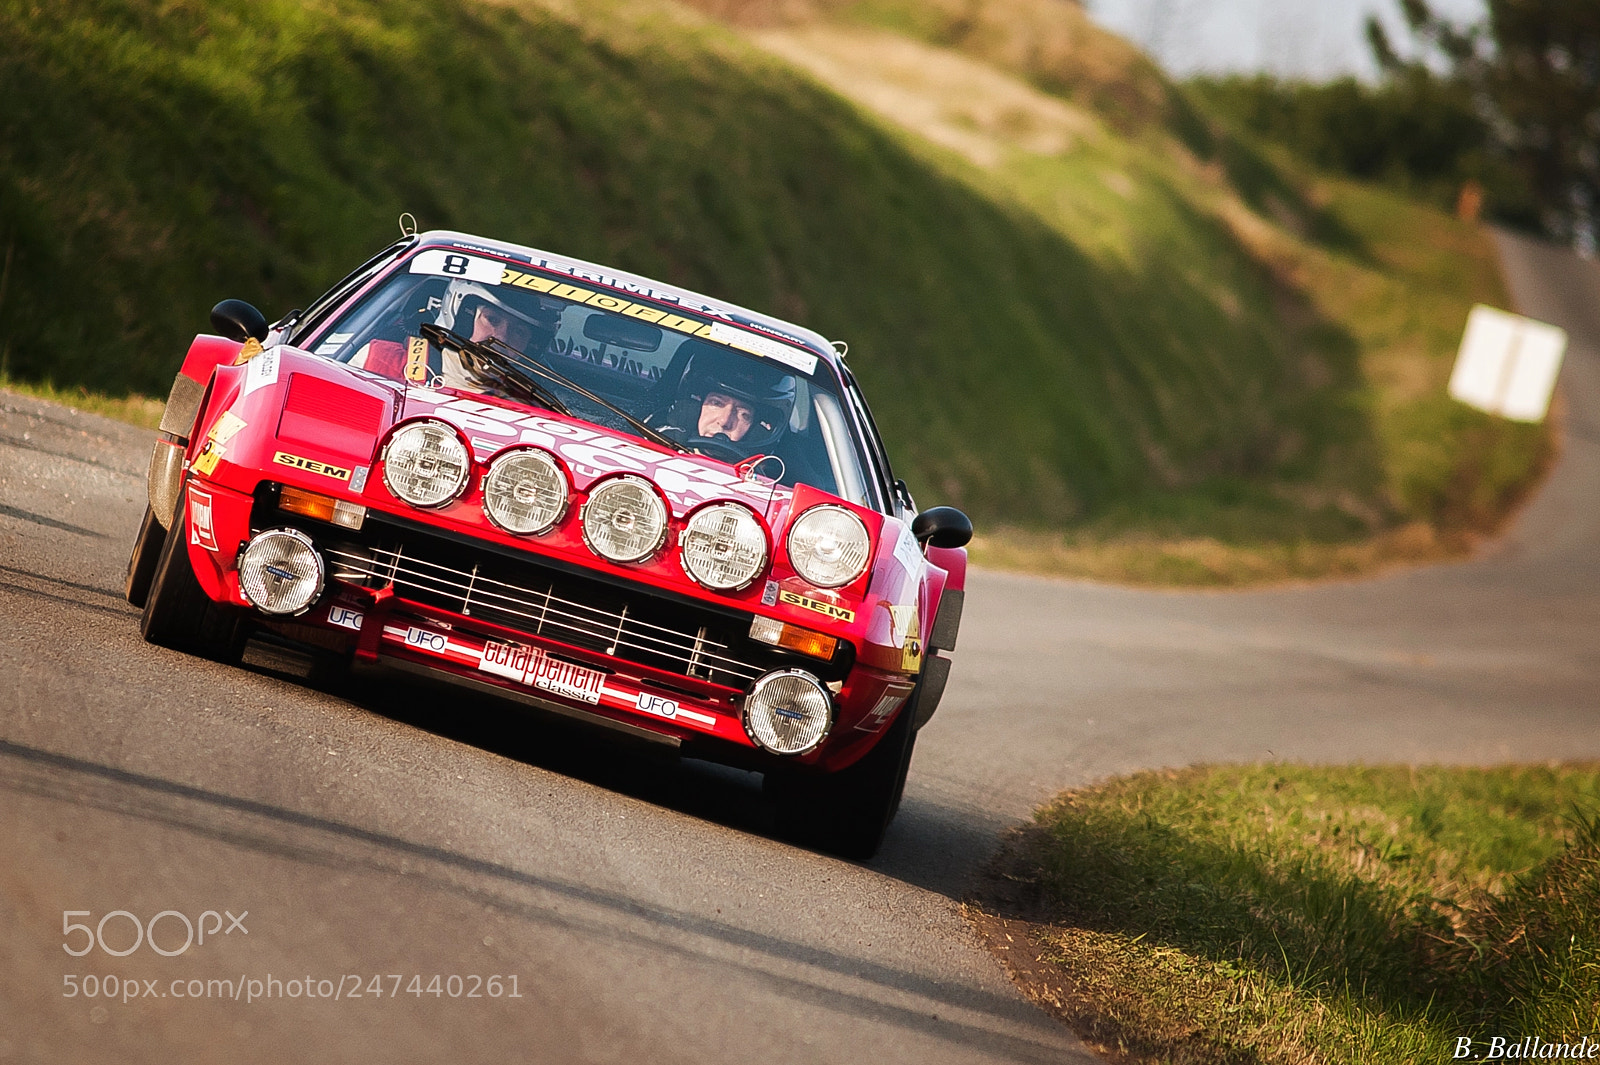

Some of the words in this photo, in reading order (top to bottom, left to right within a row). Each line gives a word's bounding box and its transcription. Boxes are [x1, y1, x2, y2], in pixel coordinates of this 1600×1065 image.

[442, 255, 470, 276] 8
[525, 254, 734, 321] TERIMPEX
[502, 272, 711, 337] LIOFI
[277, 454, 348, 478] SIEM
[784, 593, 851, 620] SIEM
[407, 627, 445, 650] UFO
[536, 679, 598, 704] classic
[639, 693, 676, 716] UFO
